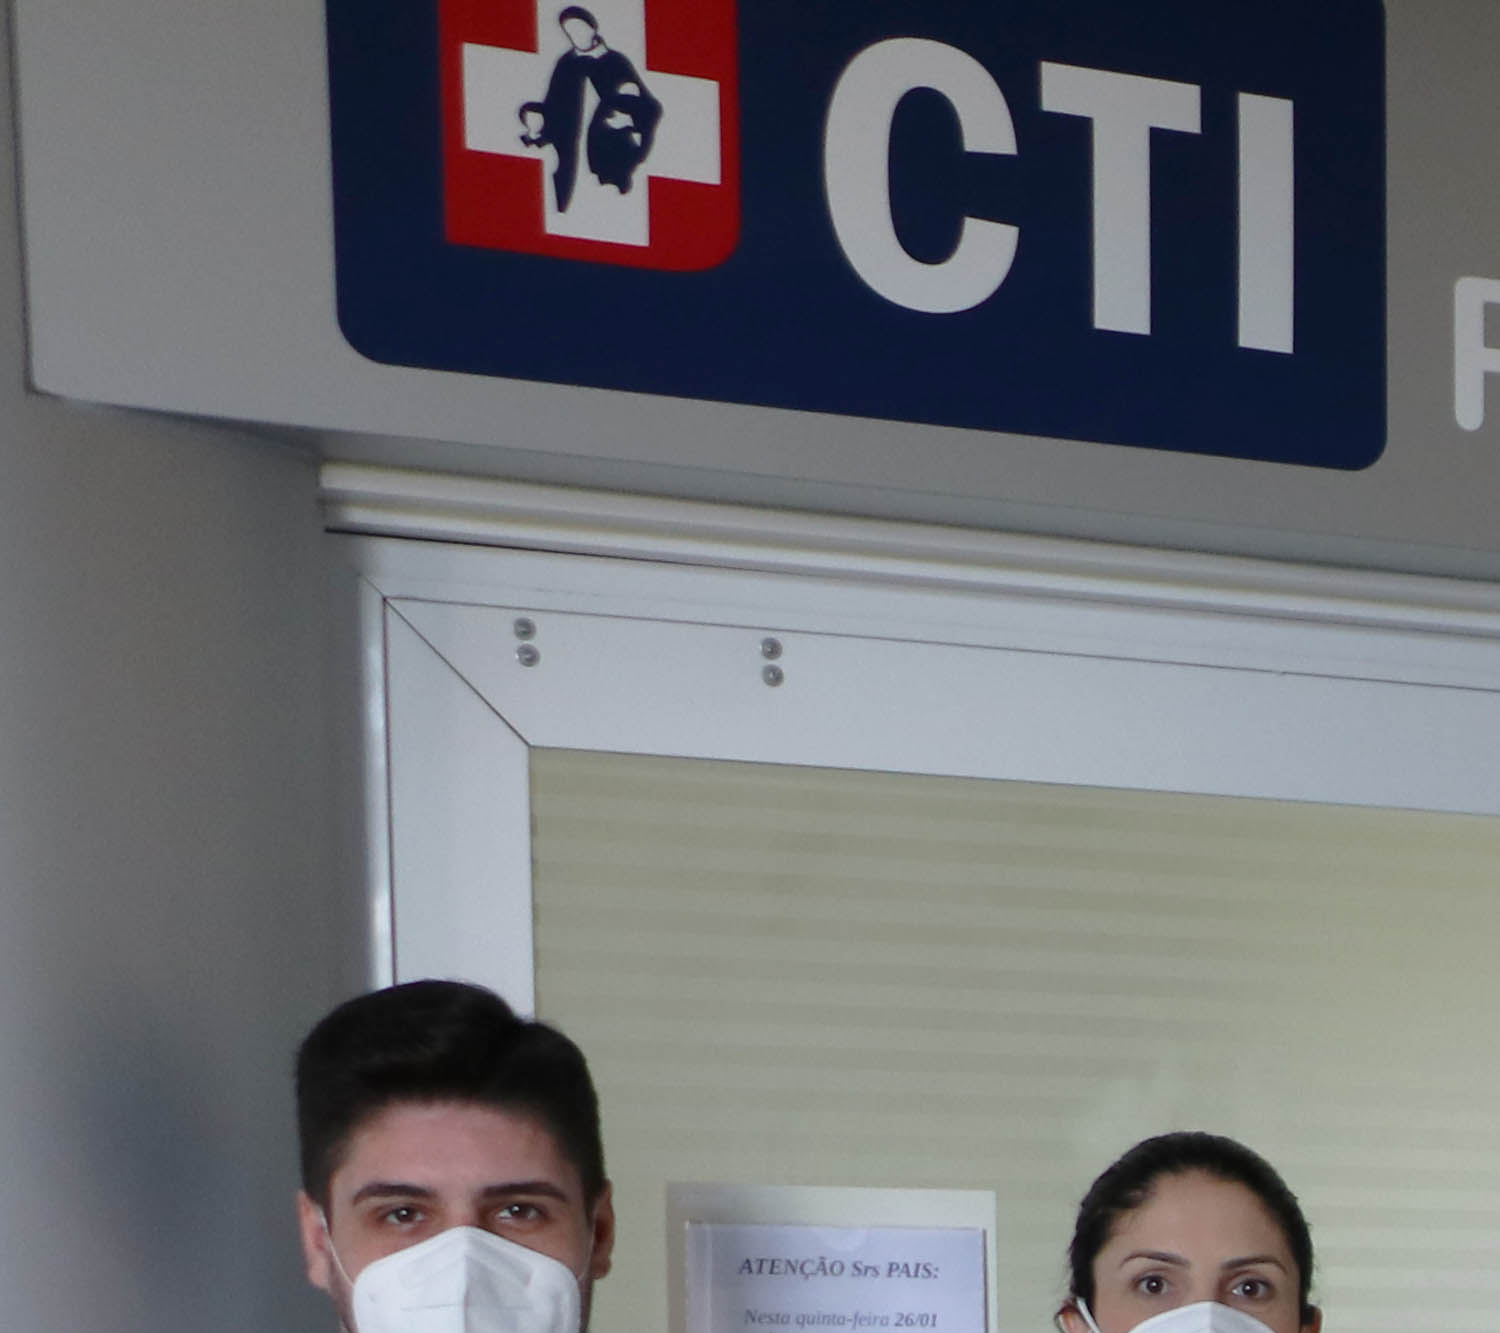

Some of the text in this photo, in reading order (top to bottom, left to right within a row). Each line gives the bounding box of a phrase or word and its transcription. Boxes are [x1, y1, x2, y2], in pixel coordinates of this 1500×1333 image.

[824, 36, 1294, 354] CTI
[738, 1256, 940, 1280] ATENÇÃO Srs PAIS:
[744, 1308, 938, 1329] Nesta quinta-feira 26/01
